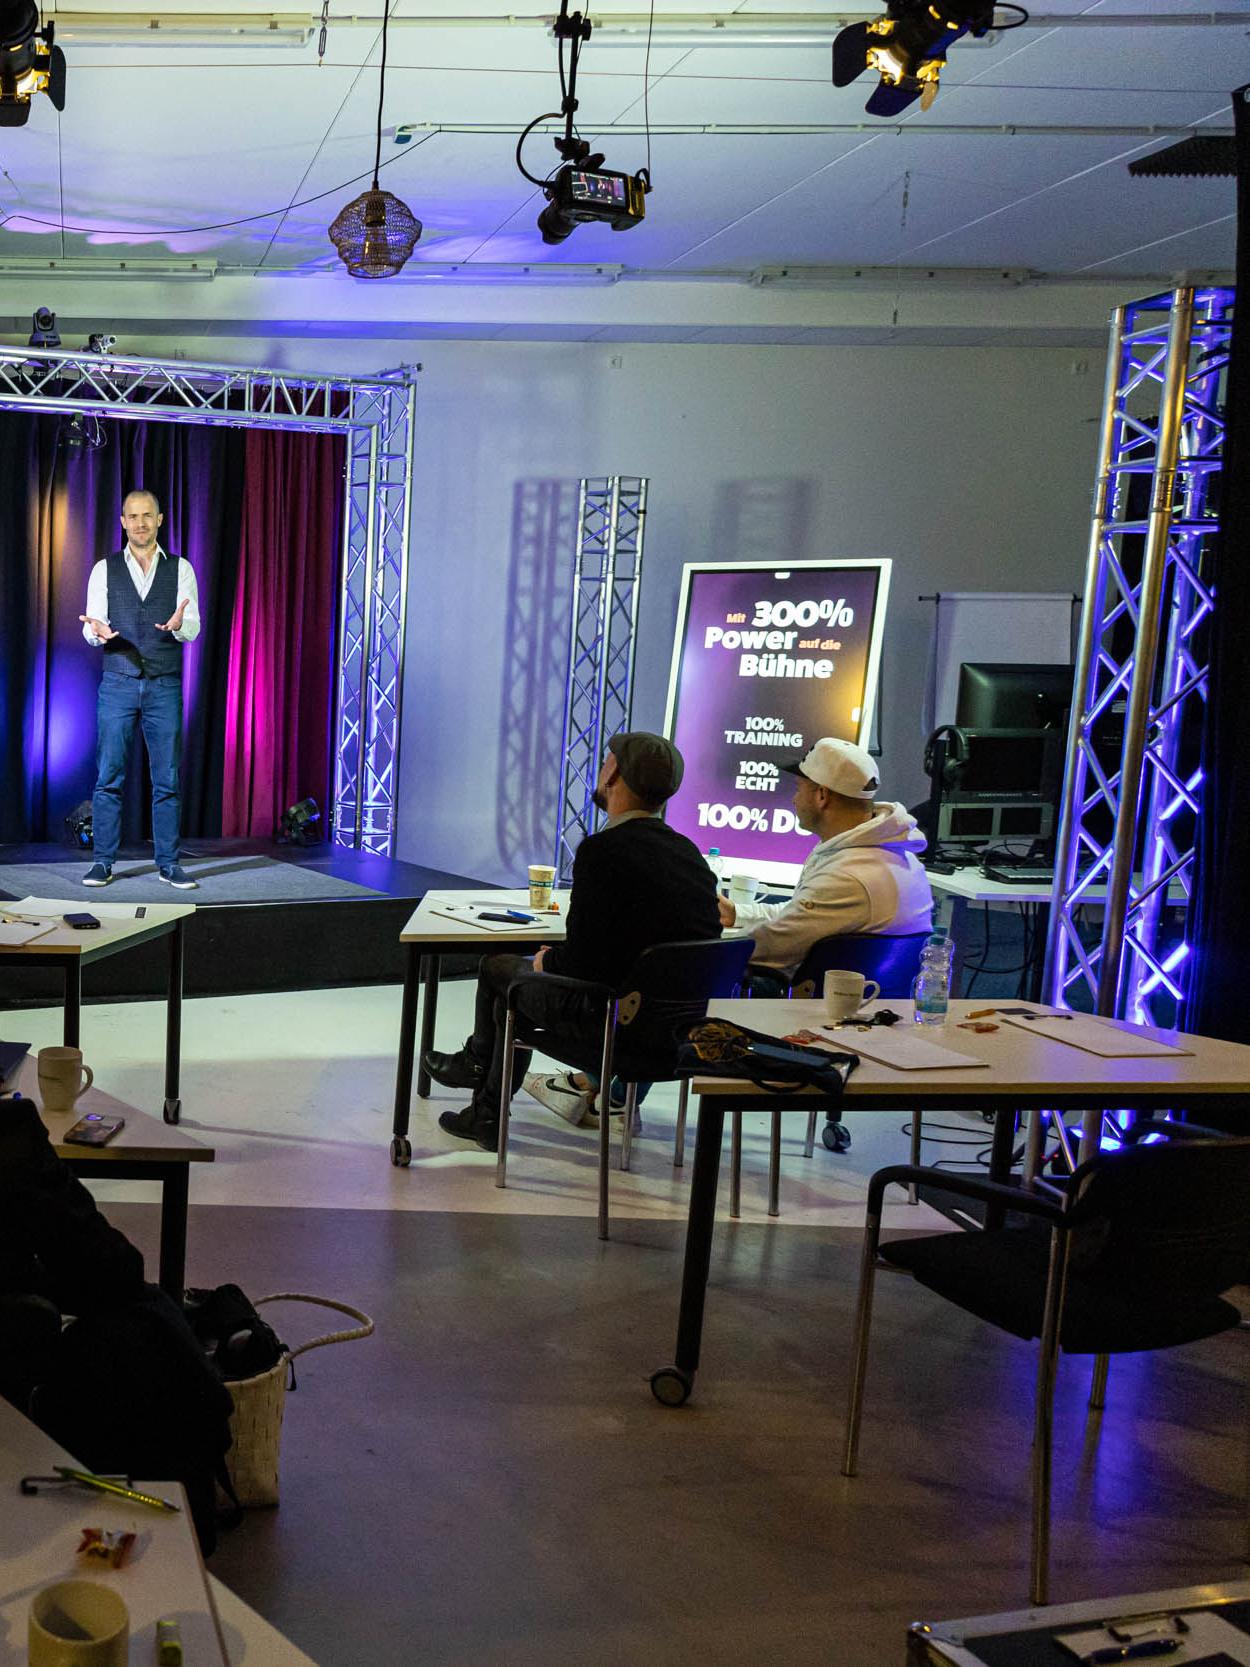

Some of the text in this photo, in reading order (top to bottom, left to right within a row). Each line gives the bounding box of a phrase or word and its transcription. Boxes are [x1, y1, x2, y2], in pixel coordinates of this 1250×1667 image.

[725, 599, 855, 629] Mit 300%
[704, 626, 842, 651] Power auf die
[739, 653, 835, 679] Bühne
[745, 716, 785, 732] 100%
[724, 730, 804, 748] TRAINING
[739, 760, 780, 777] 100%
[735, 775, 780, 792] ECHT
[697, 802, 769, 833] 100%
